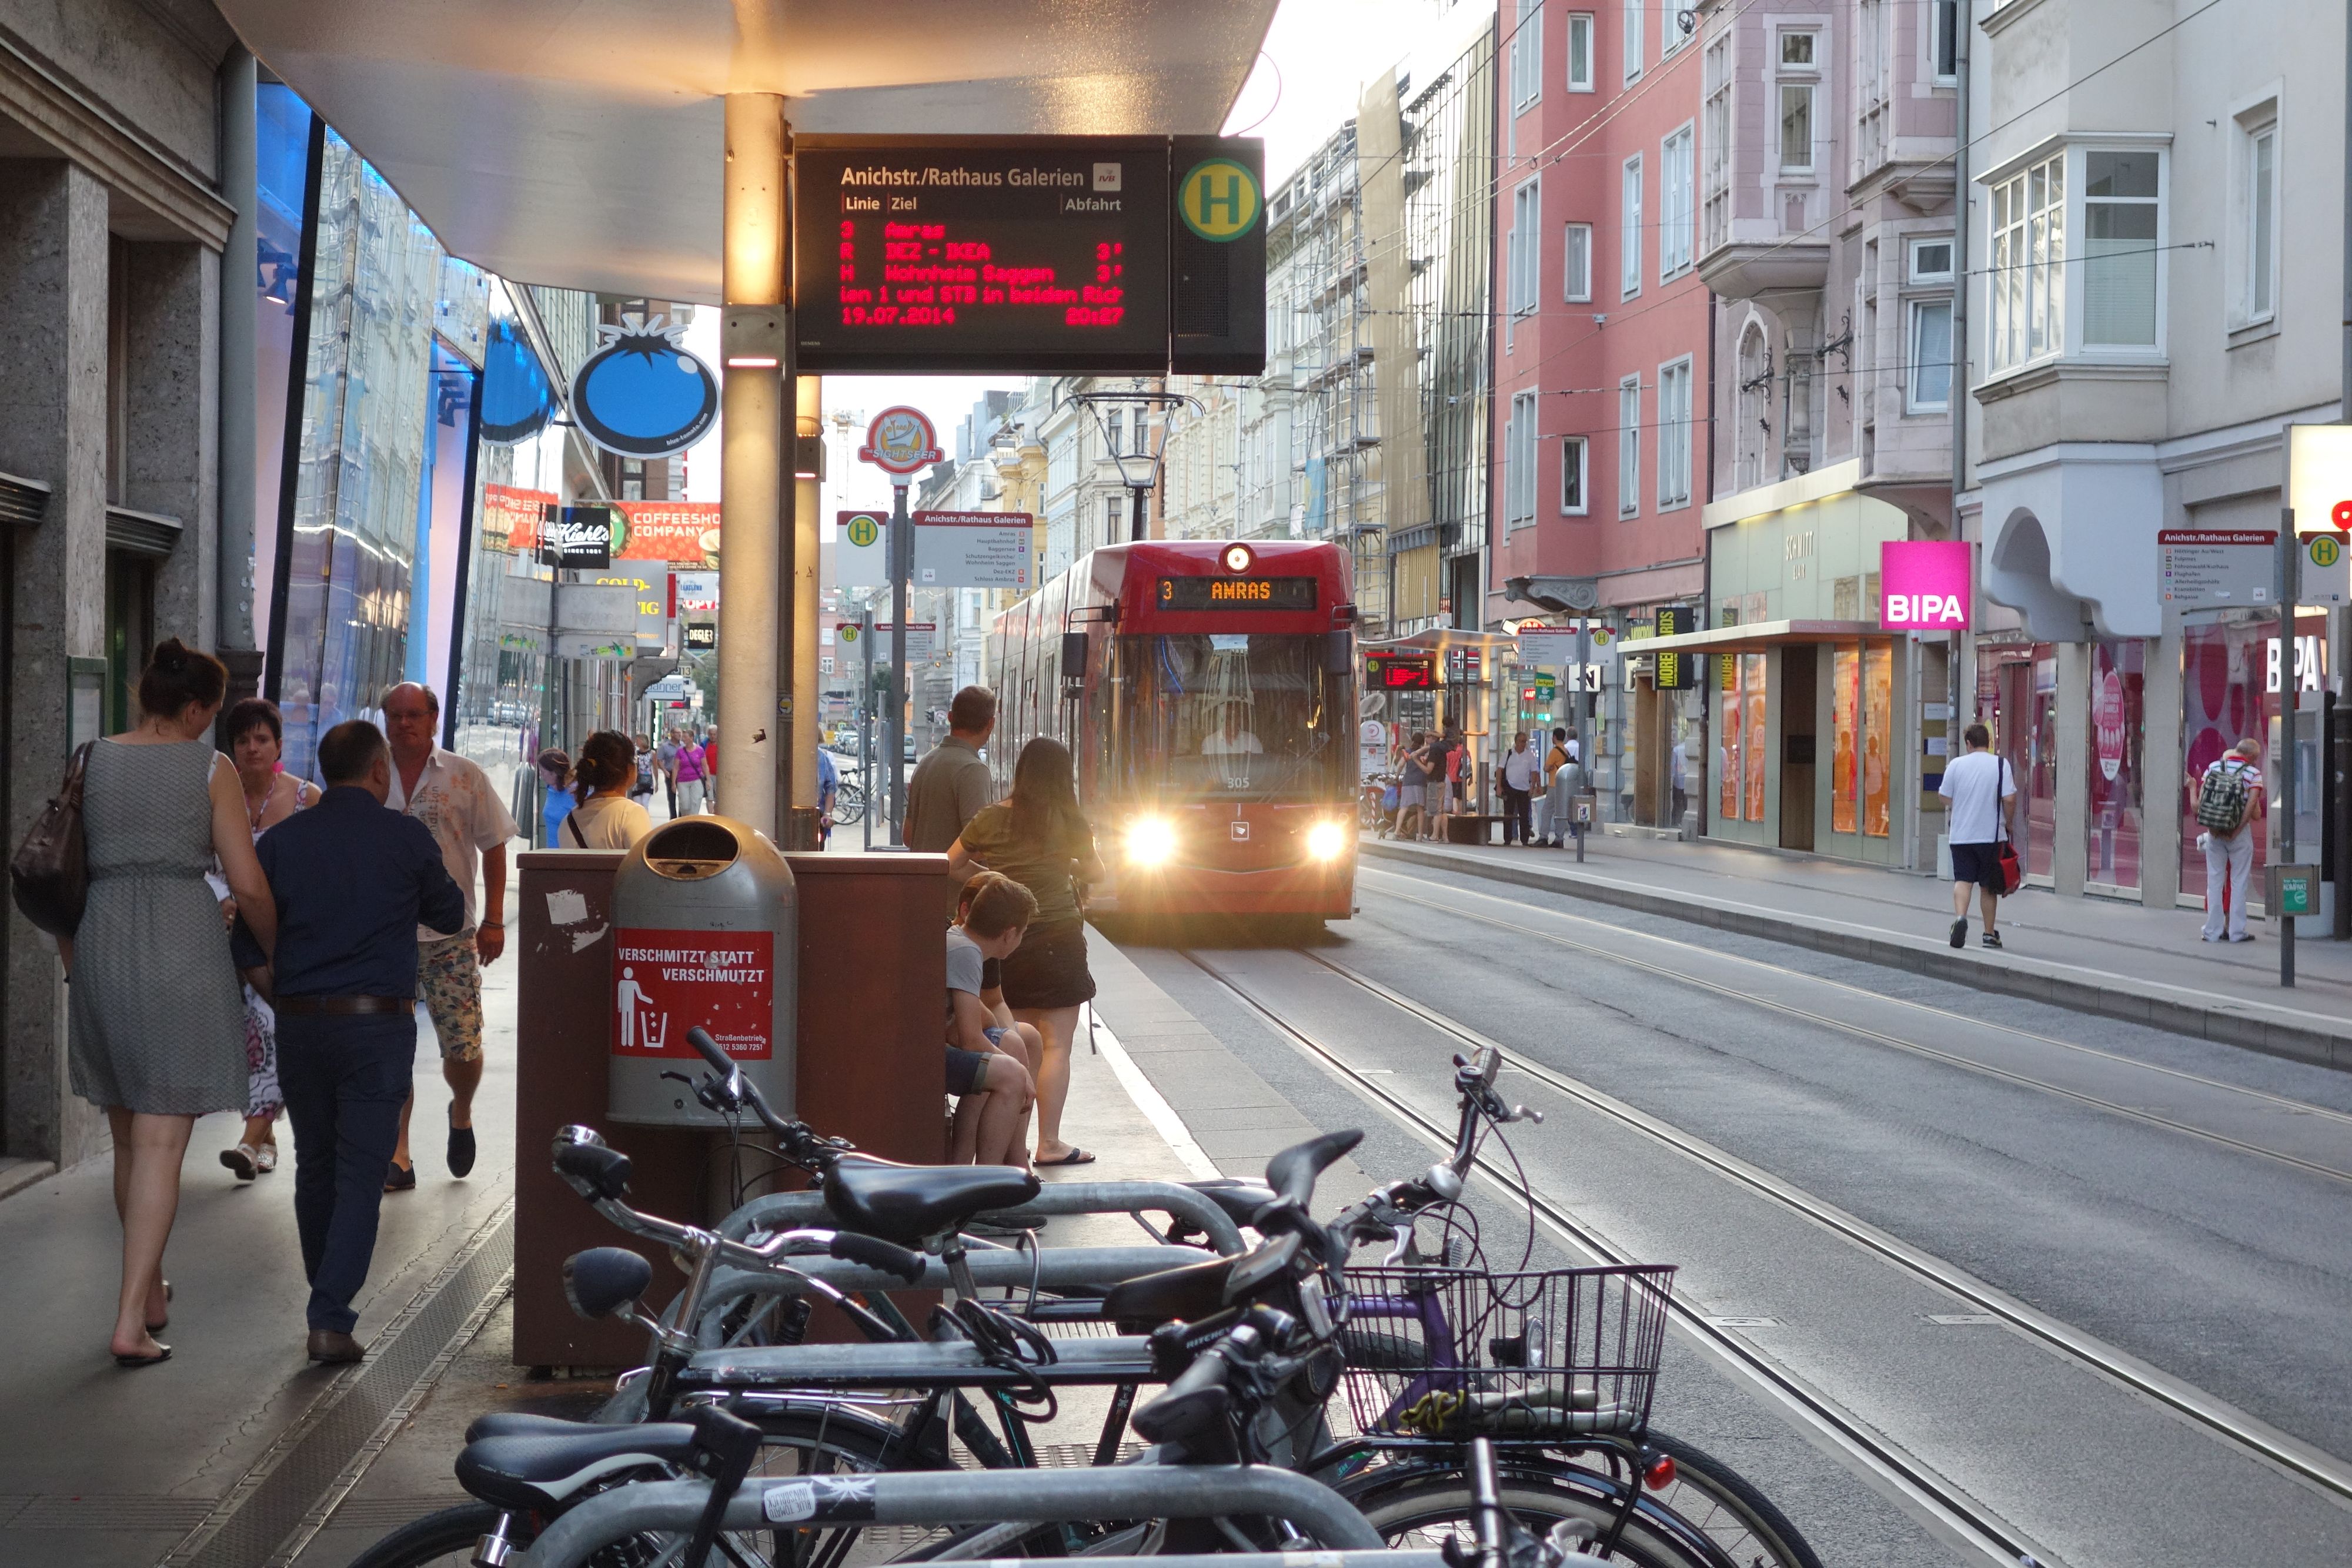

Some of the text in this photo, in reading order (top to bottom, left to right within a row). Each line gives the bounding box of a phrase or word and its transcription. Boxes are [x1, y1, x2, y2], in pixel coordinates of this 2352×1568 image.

[841, 167, 1084, 186] Anichstr./Rathaus Galerien
[846, 197, 880, 210] Linie
[891, 197, 917, 210] Ziel
[1065, 198, 1122, 211] Abfahrt
[1201, 175, 1240, 225] H
[841, 221, 945, 239] 3 Amras
[840, 242, 854, 260] R
[885, 242, 922, 260] DEZ
[945, 242, 991, 260] IKEA
[840, 264, 854, 282] H
[885, 264, 977, 282] Wohnheim
[982, 264, 1055, 286] Saggen
[879, 285, 888, 304] 1
[897, 285, 934, 304] und
[940, 285, 977, 304] STB
[983, 285, 1004, 304] in
[1009, 285, 1078, 304] beiden
[842, 307, 1124, 325] 19.07.2014 20:27
[873, 449, 936, 460] SIGHTSEER
[925, 515, 1026, 524] Anichstr./Rathaus Galerien
[557, 522, 610, 542] Kiehl's
[633, 526, 704, 537] COMPANY
[855, 524, 870, 540] H
[2164, 533, 2265, 542] Anichstr./Rathaus Galerien
[1786, 530, 1813, 561] SCHMITT
[1163, 581, 1271, 600] 3 AMRAS
[637, 601, 659, 614] IG
[1887, 594, 1965, 623] BIPA
[1659, 653, 1674, 687] MORE
[2266, 634, 2319, 693] BPA
[1227, 777, 1250, 788] 305
[618, 948, 754, 964] VERSCHMITZT STATT
[662, 968, 764, 983] VERSCHMUTZT
[767, 1487, 808, 1509] INNSBRUCK
[769, 1499, 812, 1519] BLUE TOMATO
